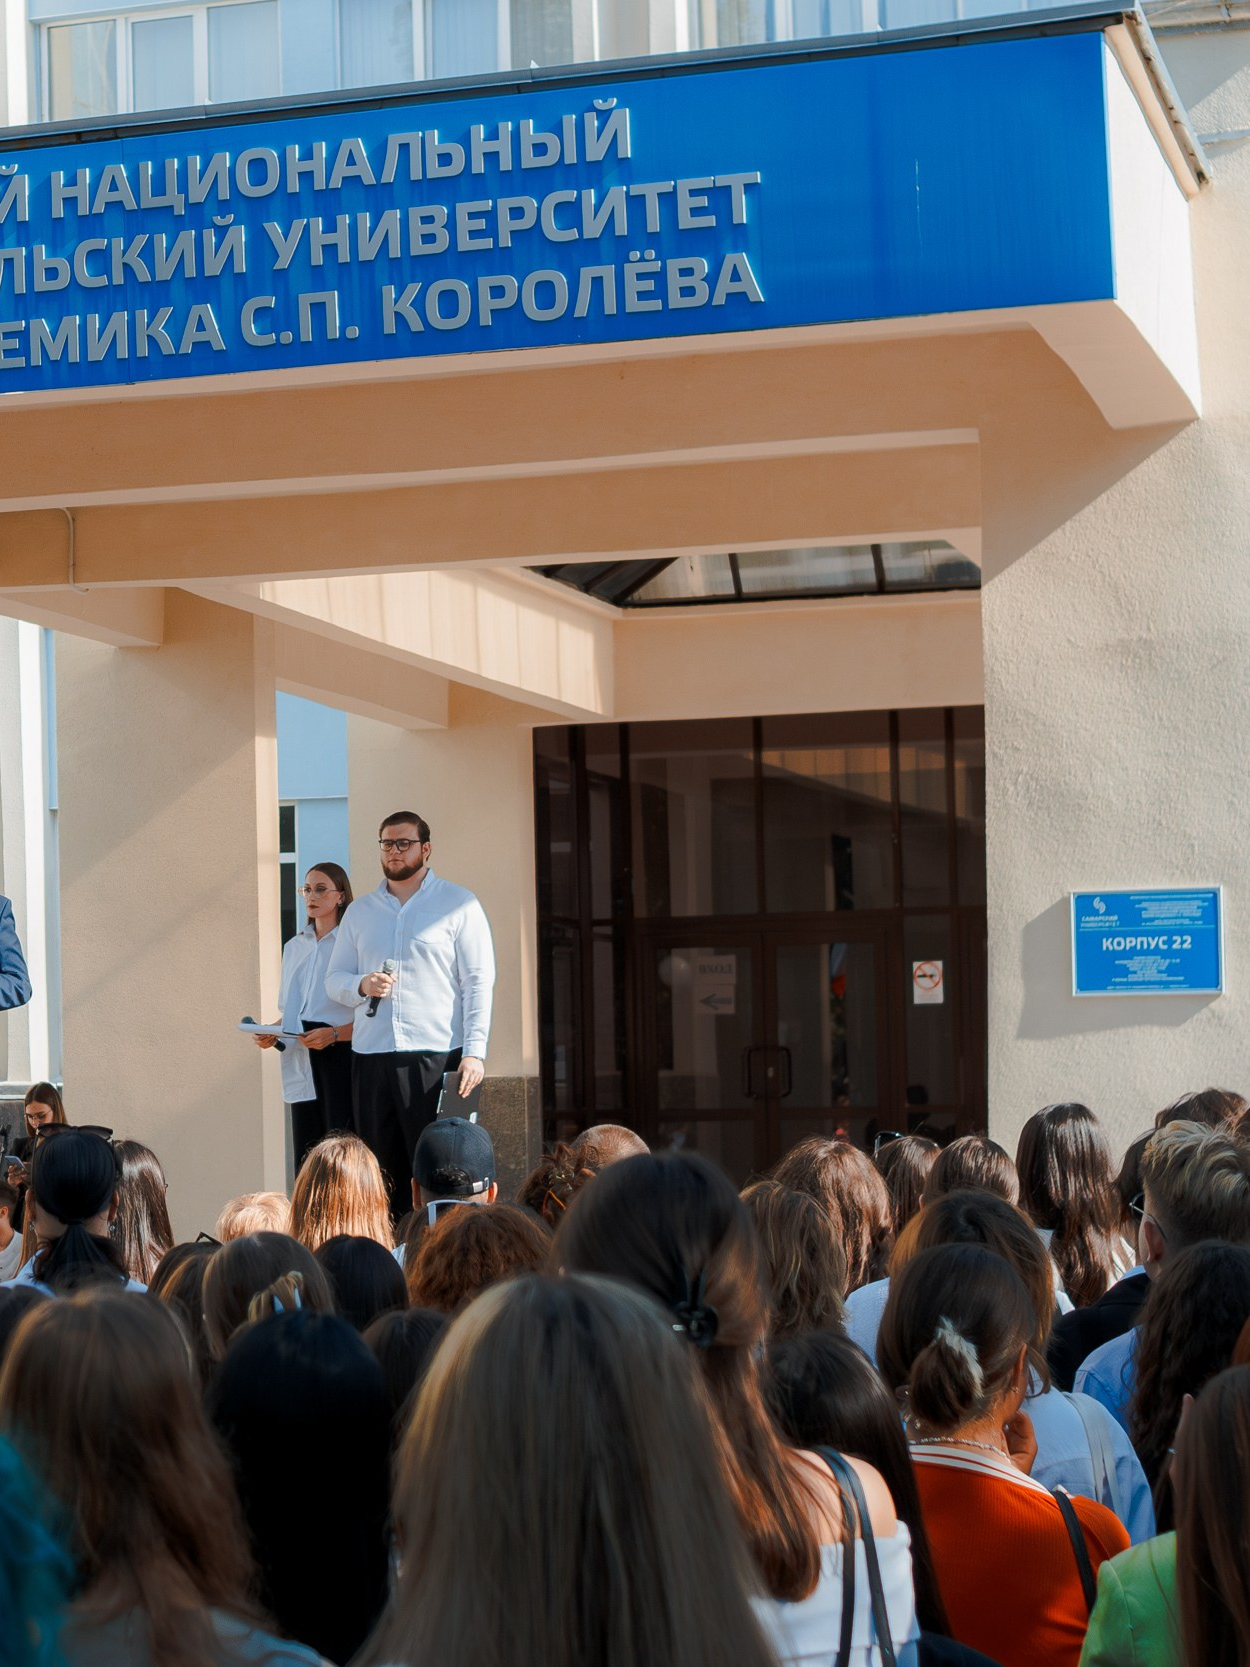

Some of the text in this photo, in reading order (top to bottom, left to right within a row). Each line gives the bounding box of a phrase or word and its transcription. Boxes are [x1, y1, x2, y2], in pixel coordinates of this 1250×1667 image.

[51, 98, 632, 219] НАЦИОНАЛЬНЫЙ
[262, 171, 762, 271] УНИВЕРСИТЕТ
[240, 289, 360, 347] С.П.
[383, 250, 766, 336] КОРОЛЁВА
[1102, 935, 1192, 951] КОРПУС 22
